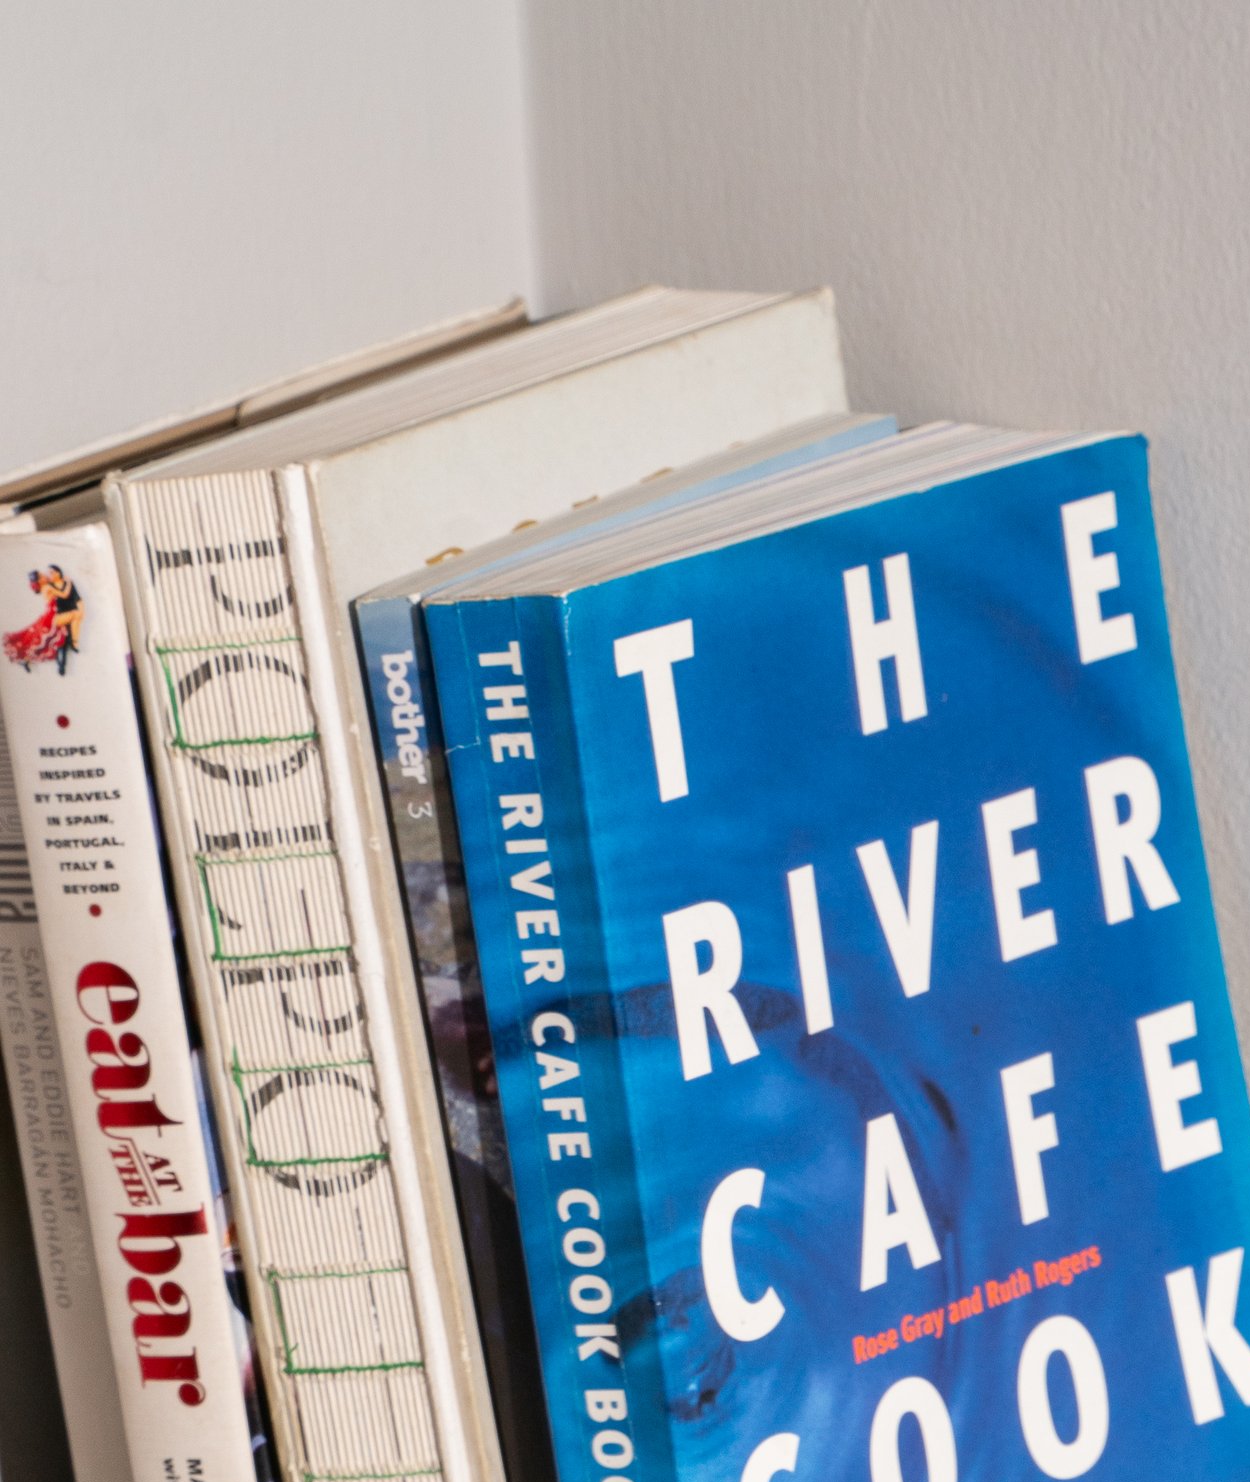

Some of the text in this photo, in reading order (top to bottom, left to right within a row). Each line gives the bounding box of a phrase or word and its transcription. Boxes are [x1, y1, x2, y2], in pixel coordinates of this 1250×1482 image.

[614, 492, 1137, 802] THE
[380, 648, 435, 820] bother 3
[478, 640, 536, 763] THE
[34, 790, 121, 803] BY TRAVELS
[39, 745, 97, 758] RECIPES
[39, 768, 105, 780] INSPIRED
[46, 816, 60, 826] IN
[60, 860, 114, 872] ITALY &
[63, 883, 120, 894] BEYOND
[499, 793, 565, 985] RIVER
[663, 756, 1180, 1081] RIVER
[31, 1007, 54, 1060] AND
[76, 961, 184, 1141] eat
[40, 1070, 69, 1142] EDDIE
[531, 1011, 592, 1161] CAFE
[55, 1153, 82, 1215] HART
[108, 1144, 152, 1207] THE
[143, 1151, 183, 1193] AT
[701, 1001, 1222, 1342] CAFE
[115, 1202, 208, 1407] bar
[556, 1188, 620, 1361] COOK
[852, 1245, 1102, 1364] Rose Gray and Ruth Rogers
